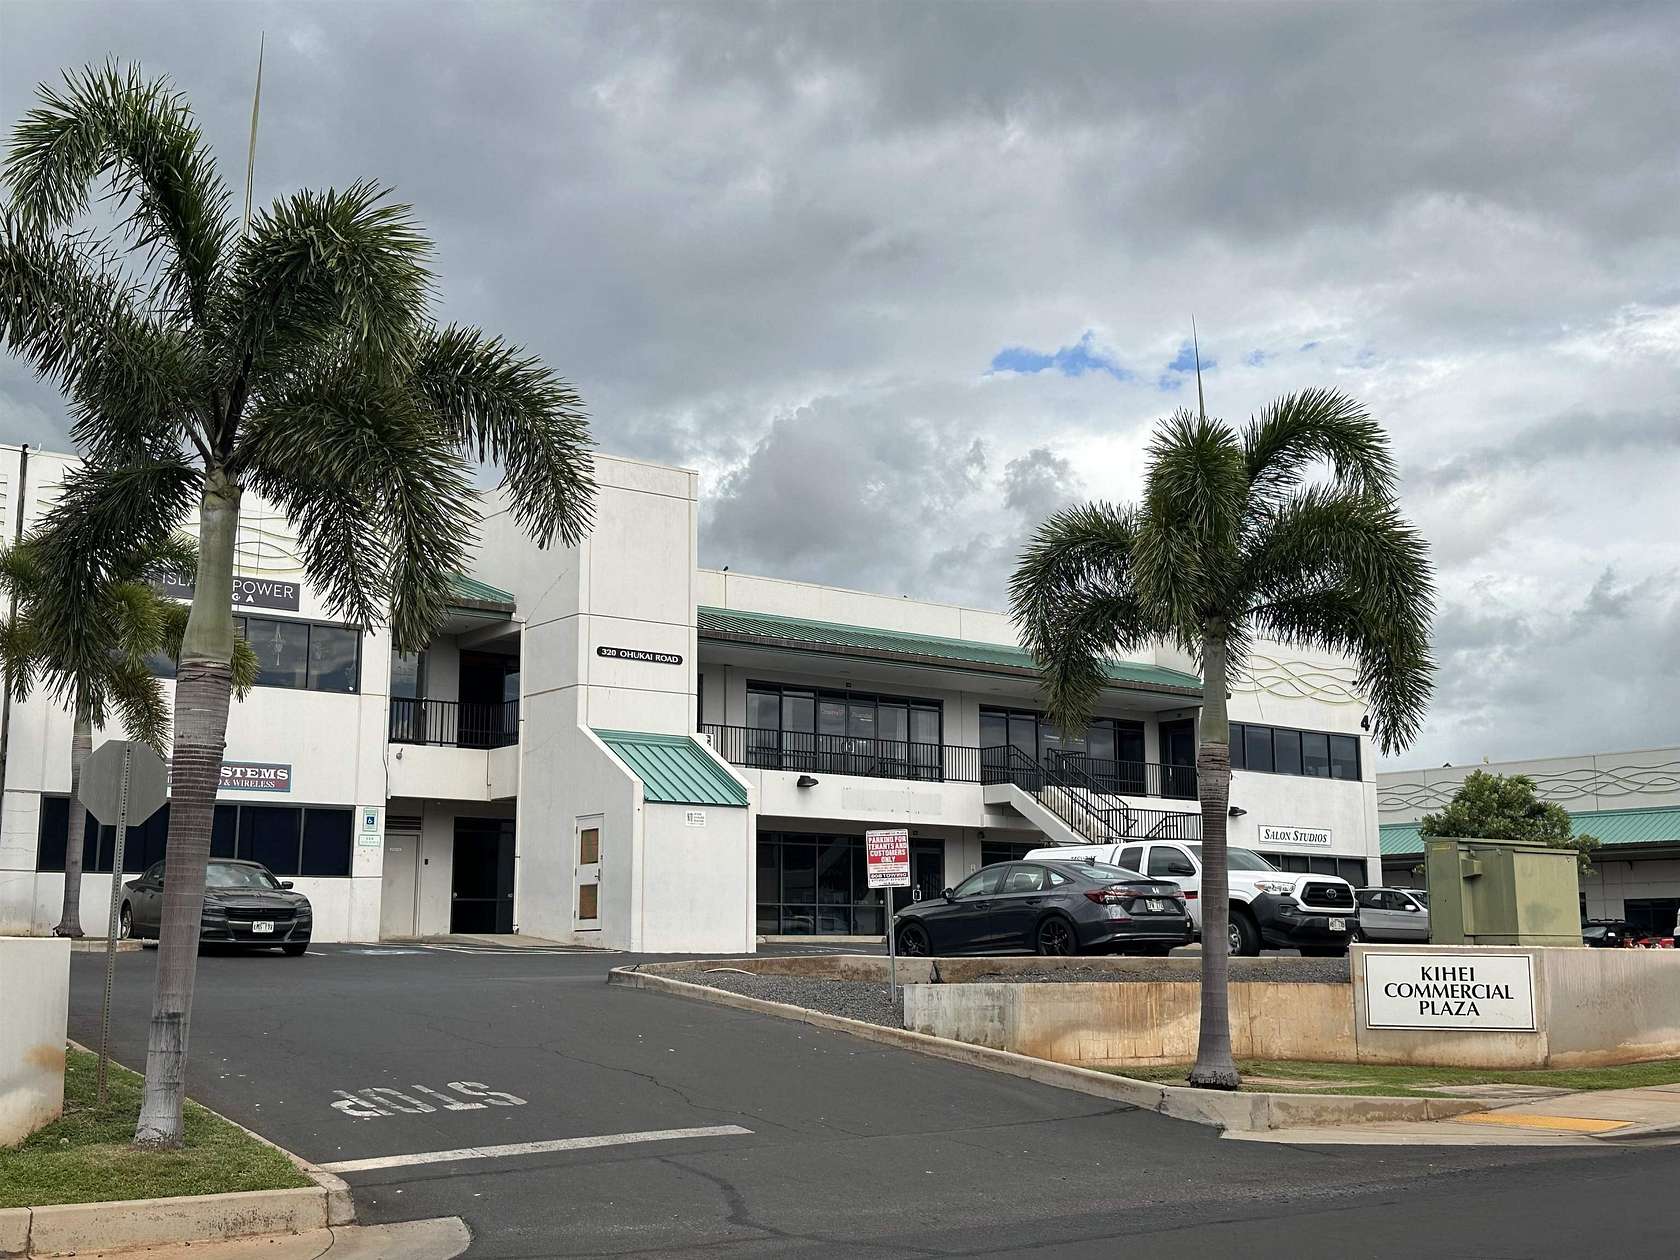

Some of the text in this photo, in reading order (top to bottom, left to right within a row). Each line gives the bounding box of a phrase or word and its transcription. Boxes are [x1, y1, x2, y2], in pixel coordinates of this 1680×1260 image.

[162, 572, 294, 599] ISL POWER
[601, 648, 679, 663] 320 OHUKAI ROAD
[1361, 715, 1370, 731] 4
[220, 766, 289, 780] STEMS
[233, 779, 275, 788] WIRELESS
[868, 836, 894, 844] PARKING
[1264, 828, 1328, 843] SALON STUDIOS
[870, 849, 906, 857] CUSTOMERS
[1420, 966, 1475, 982] KIHEI
[1384, 982, 1514, 1000] COMMERCIAL
[1419, 1000, 1480, 1016] PLAZA
[330, 1081, 528, 1117] STOP
